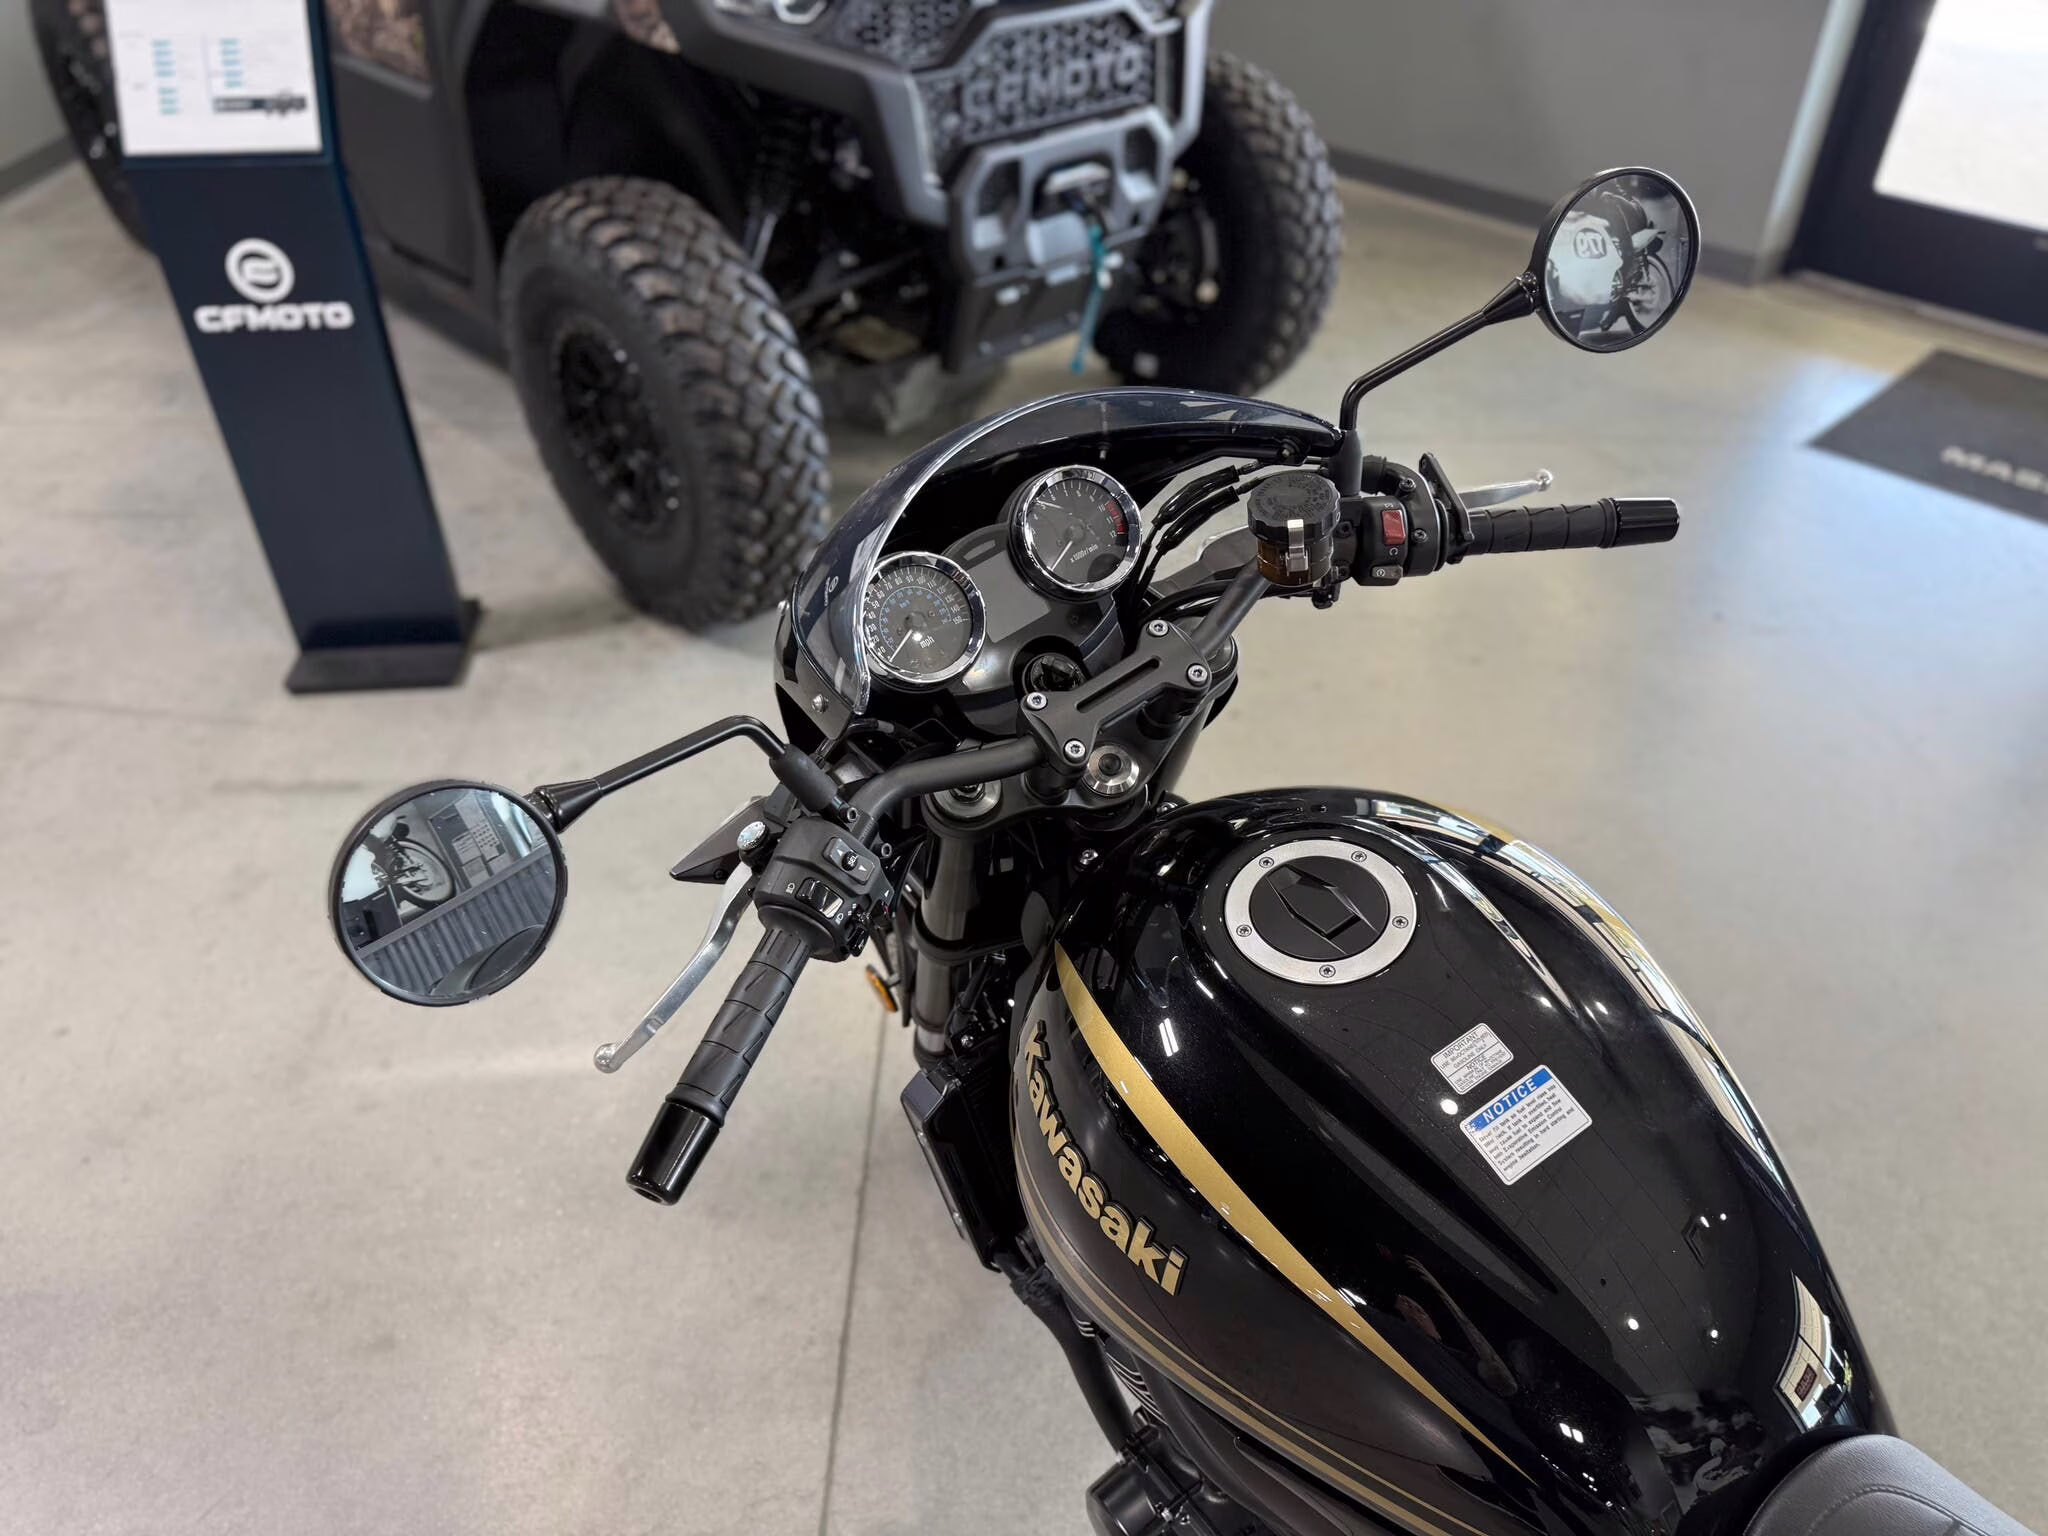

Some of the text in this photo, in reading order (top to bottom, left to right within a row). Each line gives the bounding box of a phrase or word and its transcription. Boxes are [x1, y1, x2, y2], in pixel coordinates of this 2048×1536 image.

[962, 43, 1144, 121] CFMOTO
[193, 301, 355, 333] CFMOTO
[920, 636, 934, 648] mph
[1442, 1031, 1479, 1058] IMPORTANT
[1465, 1054, 1486, 1070] NOTICE
[1480, 1078, 1538, 1123] NOTICE
[1025, 1019, 1189, 1296] Kawasaki
